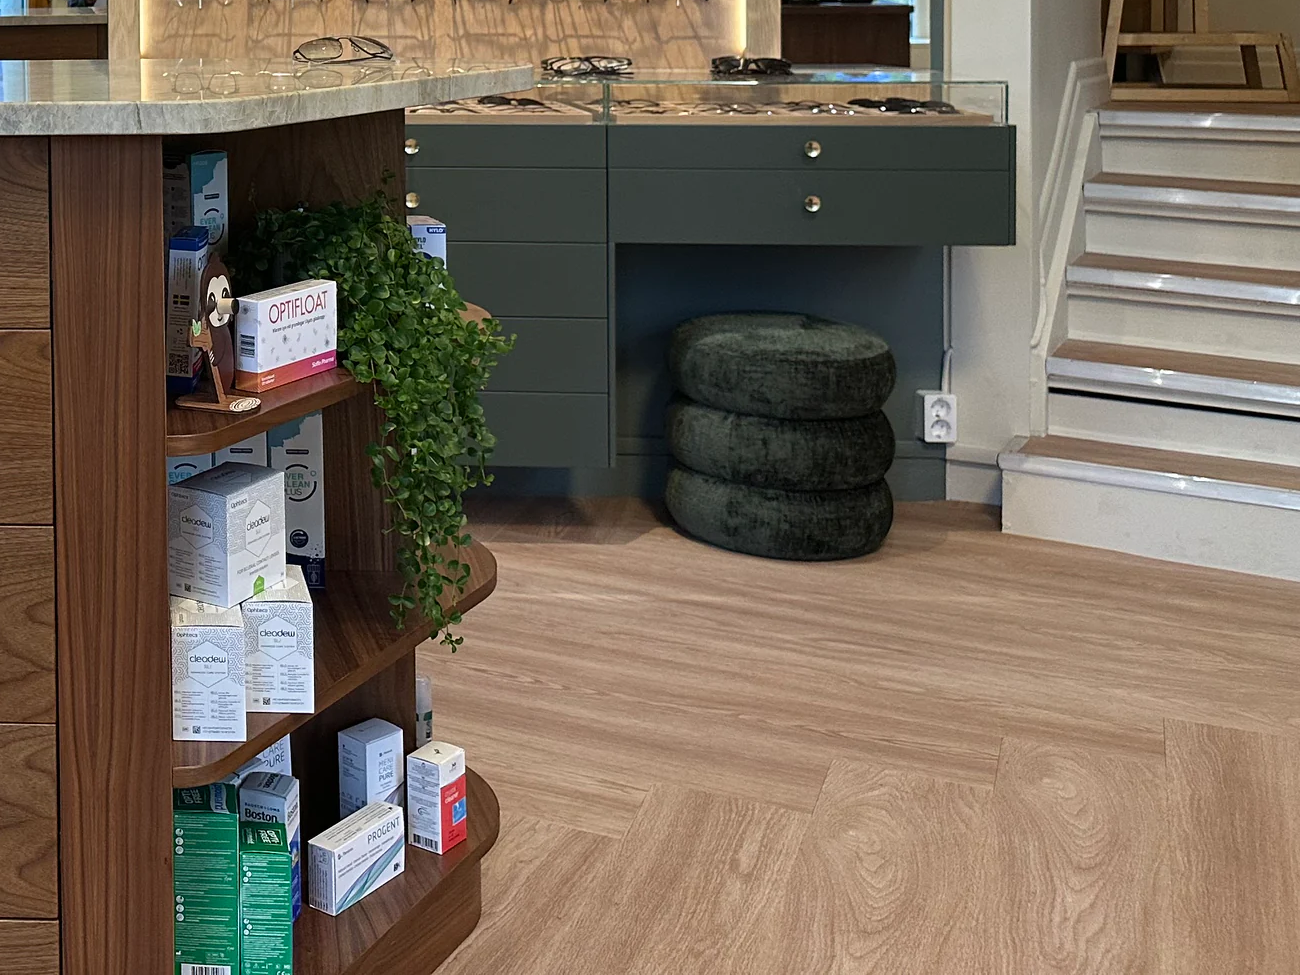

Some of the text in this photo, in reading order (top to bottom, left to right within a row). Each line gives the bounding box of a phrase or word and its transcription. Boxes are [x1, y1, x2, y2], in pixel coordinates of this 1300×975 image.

[269, 290, 328, 324] OPTIFLOAT
[378, 770, 394, 782] PURE
[245, 808, 278, 823] Boston
[367, 816, 400, 845] PROGENT
